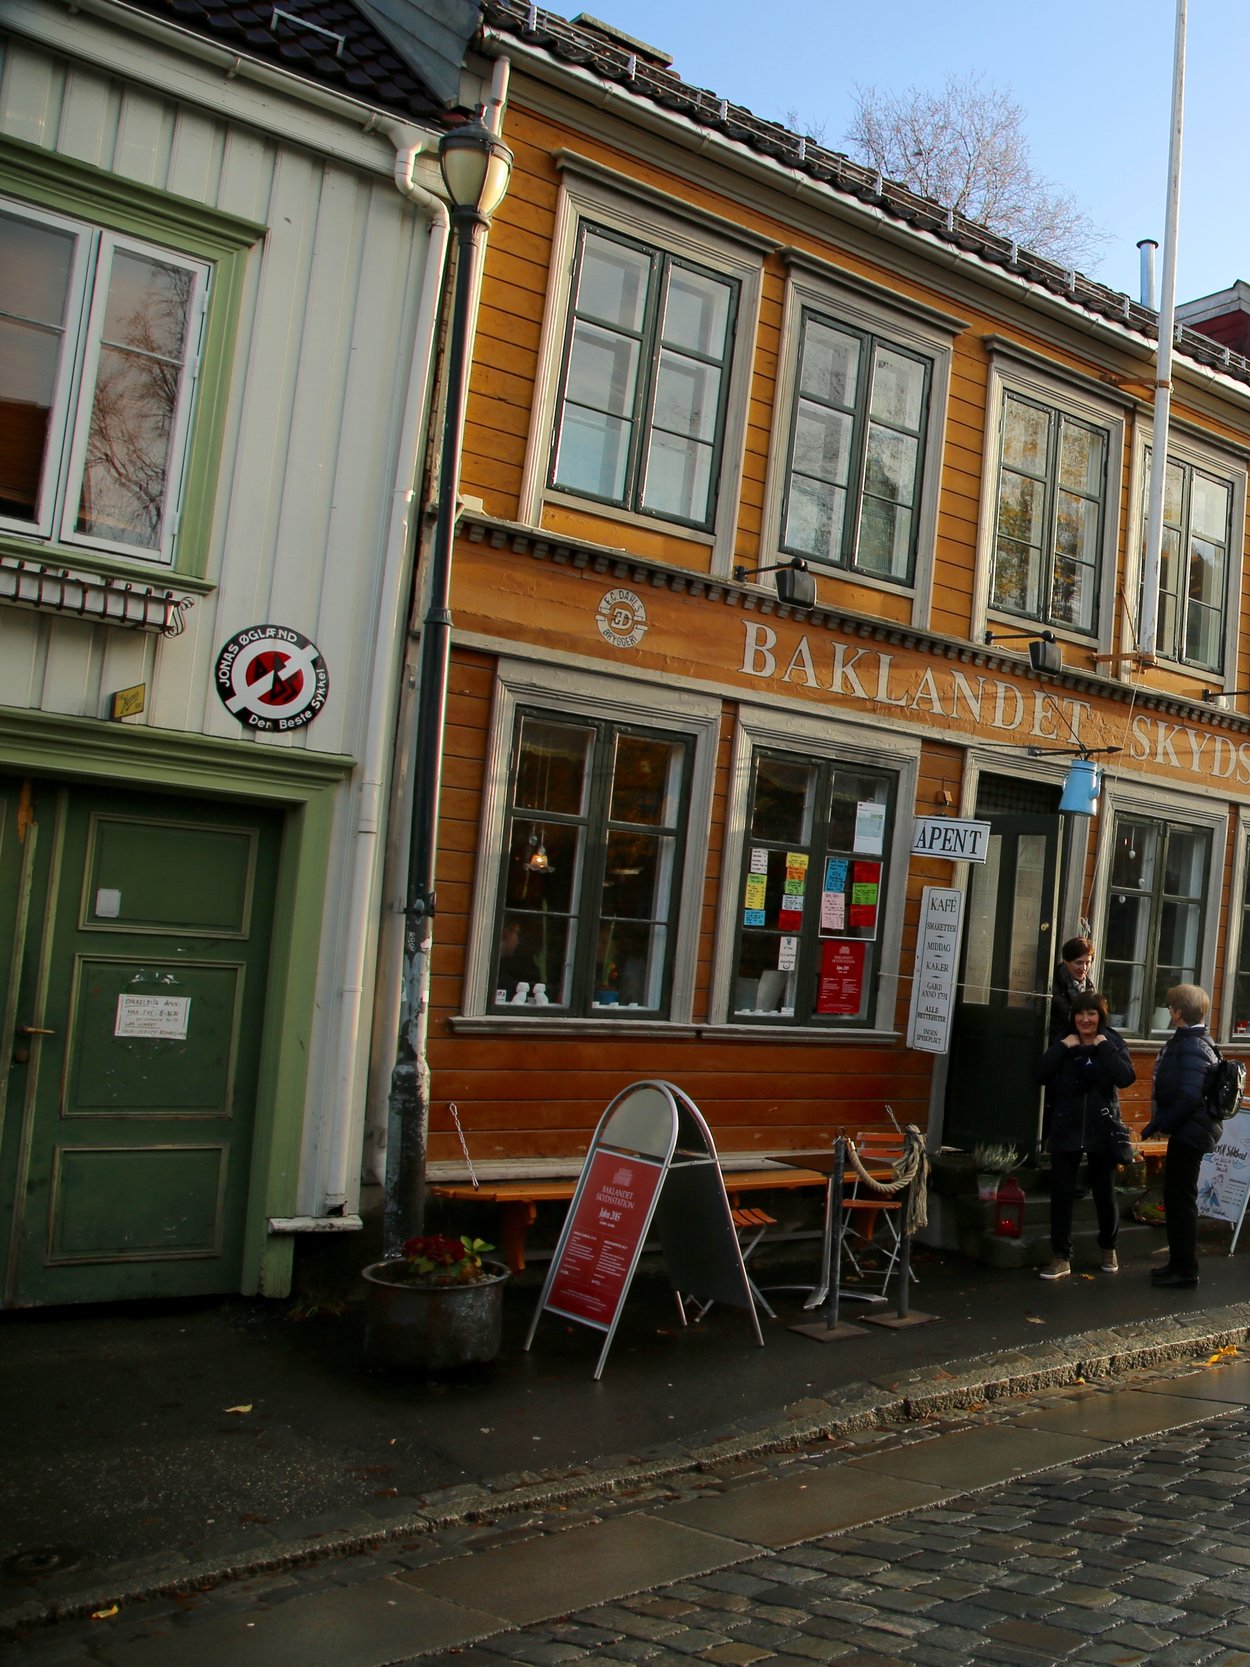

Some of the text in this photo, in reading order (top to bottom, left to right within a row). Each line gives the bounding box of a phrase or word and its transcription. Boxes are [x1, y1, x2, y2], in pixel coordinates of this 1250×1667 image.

[602, 628, 638, 647] BRYGGERI
[219, 627, 298, 688] JONAS ØGLÆND
[737, 619, 1092, 746] BAKLANDET
[279, 709, 313, 730] Beste
[311, 668, 327, 710] Sykkel
[913, 820, 982, 855] ÅPENT
[930, 896, 957, 913] KAFÉ
[927, 941, 951, 957] MIDDAG
[925, 961, 949, 973] KAKER
[922, 990, 937, 999] ANNO
[924, 1005, 939, 1014] ALLE
[922, 1028, 938, 1037] INGEN
